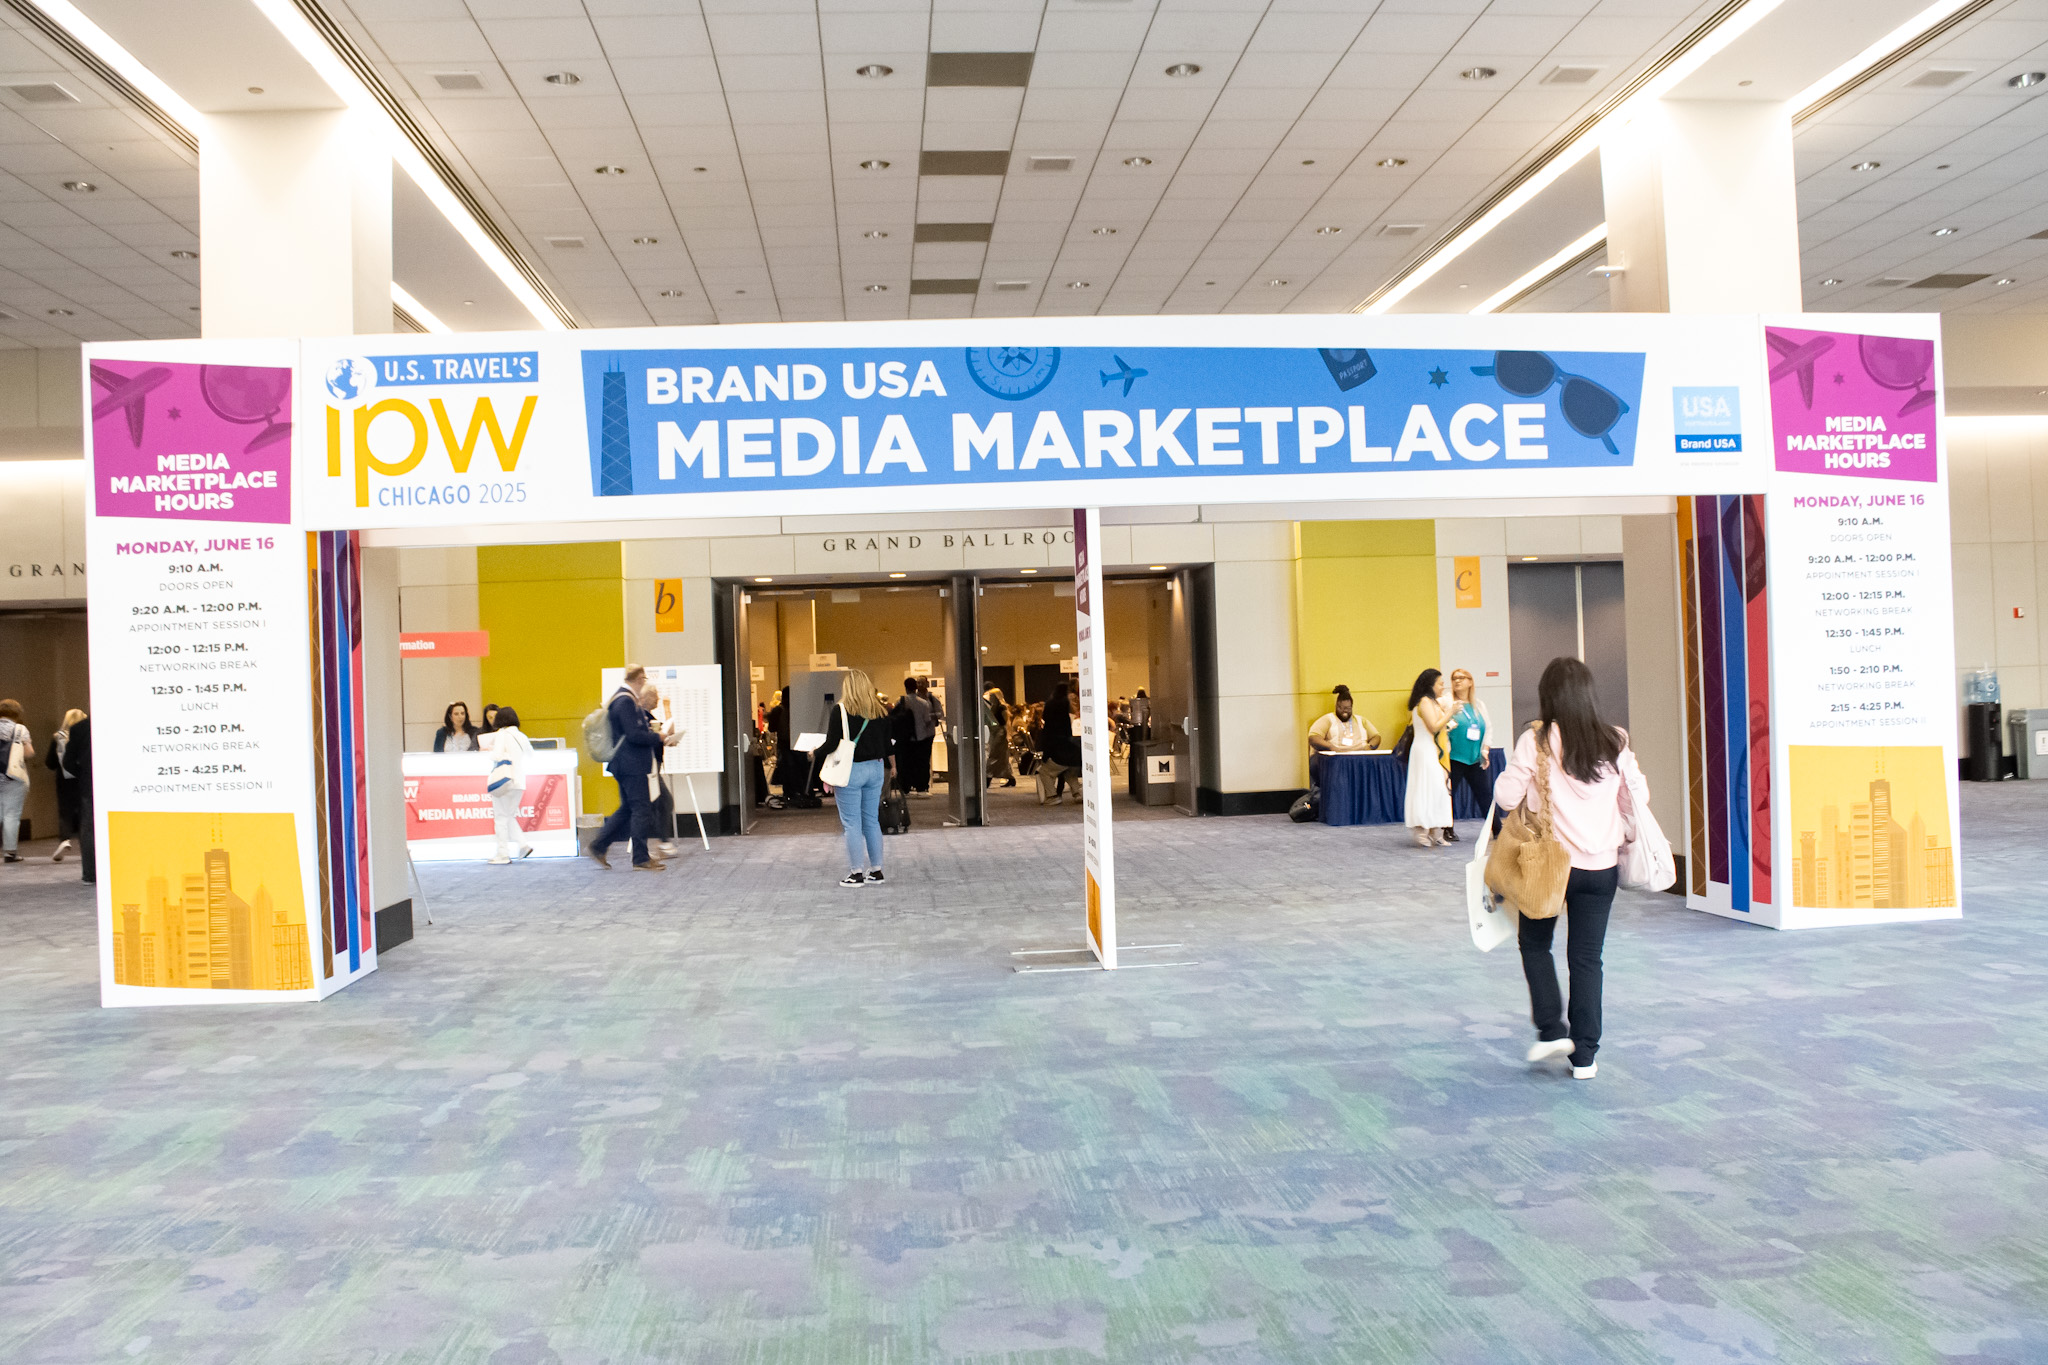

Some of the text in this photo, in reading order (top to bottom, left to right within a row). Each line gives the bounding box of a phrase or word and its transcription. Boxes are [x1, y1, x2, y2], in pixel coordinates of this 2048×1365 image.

[384, 356, 532, 382] U.S. TRAVEL'S
[646, 360, 947, 405] BRAND USA
[1681, 395, 1731, 418] USA
[1825, 416, 1886, 433] MEDIA
[657, 403, 1549, 480] MEDIA MARKETPLACE
[1680, 438, 1736, 449] Brand USA
[1786, 433, 1926, 451] MARKETPLACE
[326, 395, 539, 508] ipw
[157, 452, 230, 472] MEDIA
[1824, 453, 1891, 469] HOURS
[110, 471, 277, 494] MARKETPLACE
[378, 482, 527, 507] CHICAGO 2025
[154, 492, 234, 512] HOURS
[1793, 494, 1925, 509] MONDAY, JUNE 16
[1837, 517, 1884, 526] 9:10 A.M.
[823, 530, 1074, 552] GRAND BALLROO
[1830, 533, 1892, 542] DOORS OPEN
[116, 537, 275, 555] MONDAY, JUNE 16
[1808, 555, 1831, 564] 9:20
[1834, 555, 1856, 563] A.M.
[1865, 554, 1893, 562] 12:00
[1896, 553, 1916, 562] P.M.
[9, 562, 86, 578] GRAN
[168, 563, 224, 574] 9:10 A.M.
[159, 581, 234, 591] DOORS OPEN
[655, 582, 675, 615] b
[1821, 592, 1850, 601] 12:00
[1859, 591, 1883, 600] 12:15
[1885, 590, 1906, 599] P.M.
[132, 605, 159, 615] 9:20
[163, 605, 190, 614] A.M.
[201, 603, 234, 613] 12:00
[238, 602, 262, 612] P.M.
[129, 621, 209, 633] APPOINTMENT
[212, 620, 260, 630] SESSION
[1825, 629, 1852, 638] 12:30
[1861, 628, 1882, 637] 1:45
[1884, 627, 1905, 636] P.M.
[147, 645, 181, 655] 12:00
[193, 644, 221, 653] 12:15
[224, 643, 249, 652] P.M.
[400, 640, 435, 650] rmation
[139, 660, 258, 673] NETWORKING BREAK
[1829, 666, 1850, 675] 1:50
[1859, 665, 1880, 674] 2:10
[1883, 664, 1903, 673] P.M.
[151, 685, 184, 695] 12:30
[195, 684, 219, 694] 1:45
[222, 683, 247, 692] P.M.
[180, 702, 219, 711] LUNCH
[1830, 703, 1850, 712] 2:15
[1859, 702, 1882, 711] 4:25
[1884, 701, 1905, 710] P.M.
[156, 726, 181, 735] 1:50
[192, 724, 217, 734] 2:10
[220, 724, 245, 733] P.M.
[142, 741, 260, 753] NETWORKING BREAK
[157, 766, 181, 776] 2:15
[192, 765, 219, 774] 4:25
[222, 764, 246, 773] P.M.
[132, 783, 213, 794] APPOINTMENT
[216, 781, 263, 791] SESSION
[452, 794, 480, 803] BRAND
[418, 806, 535, 821] MEDIA MARKEACE
